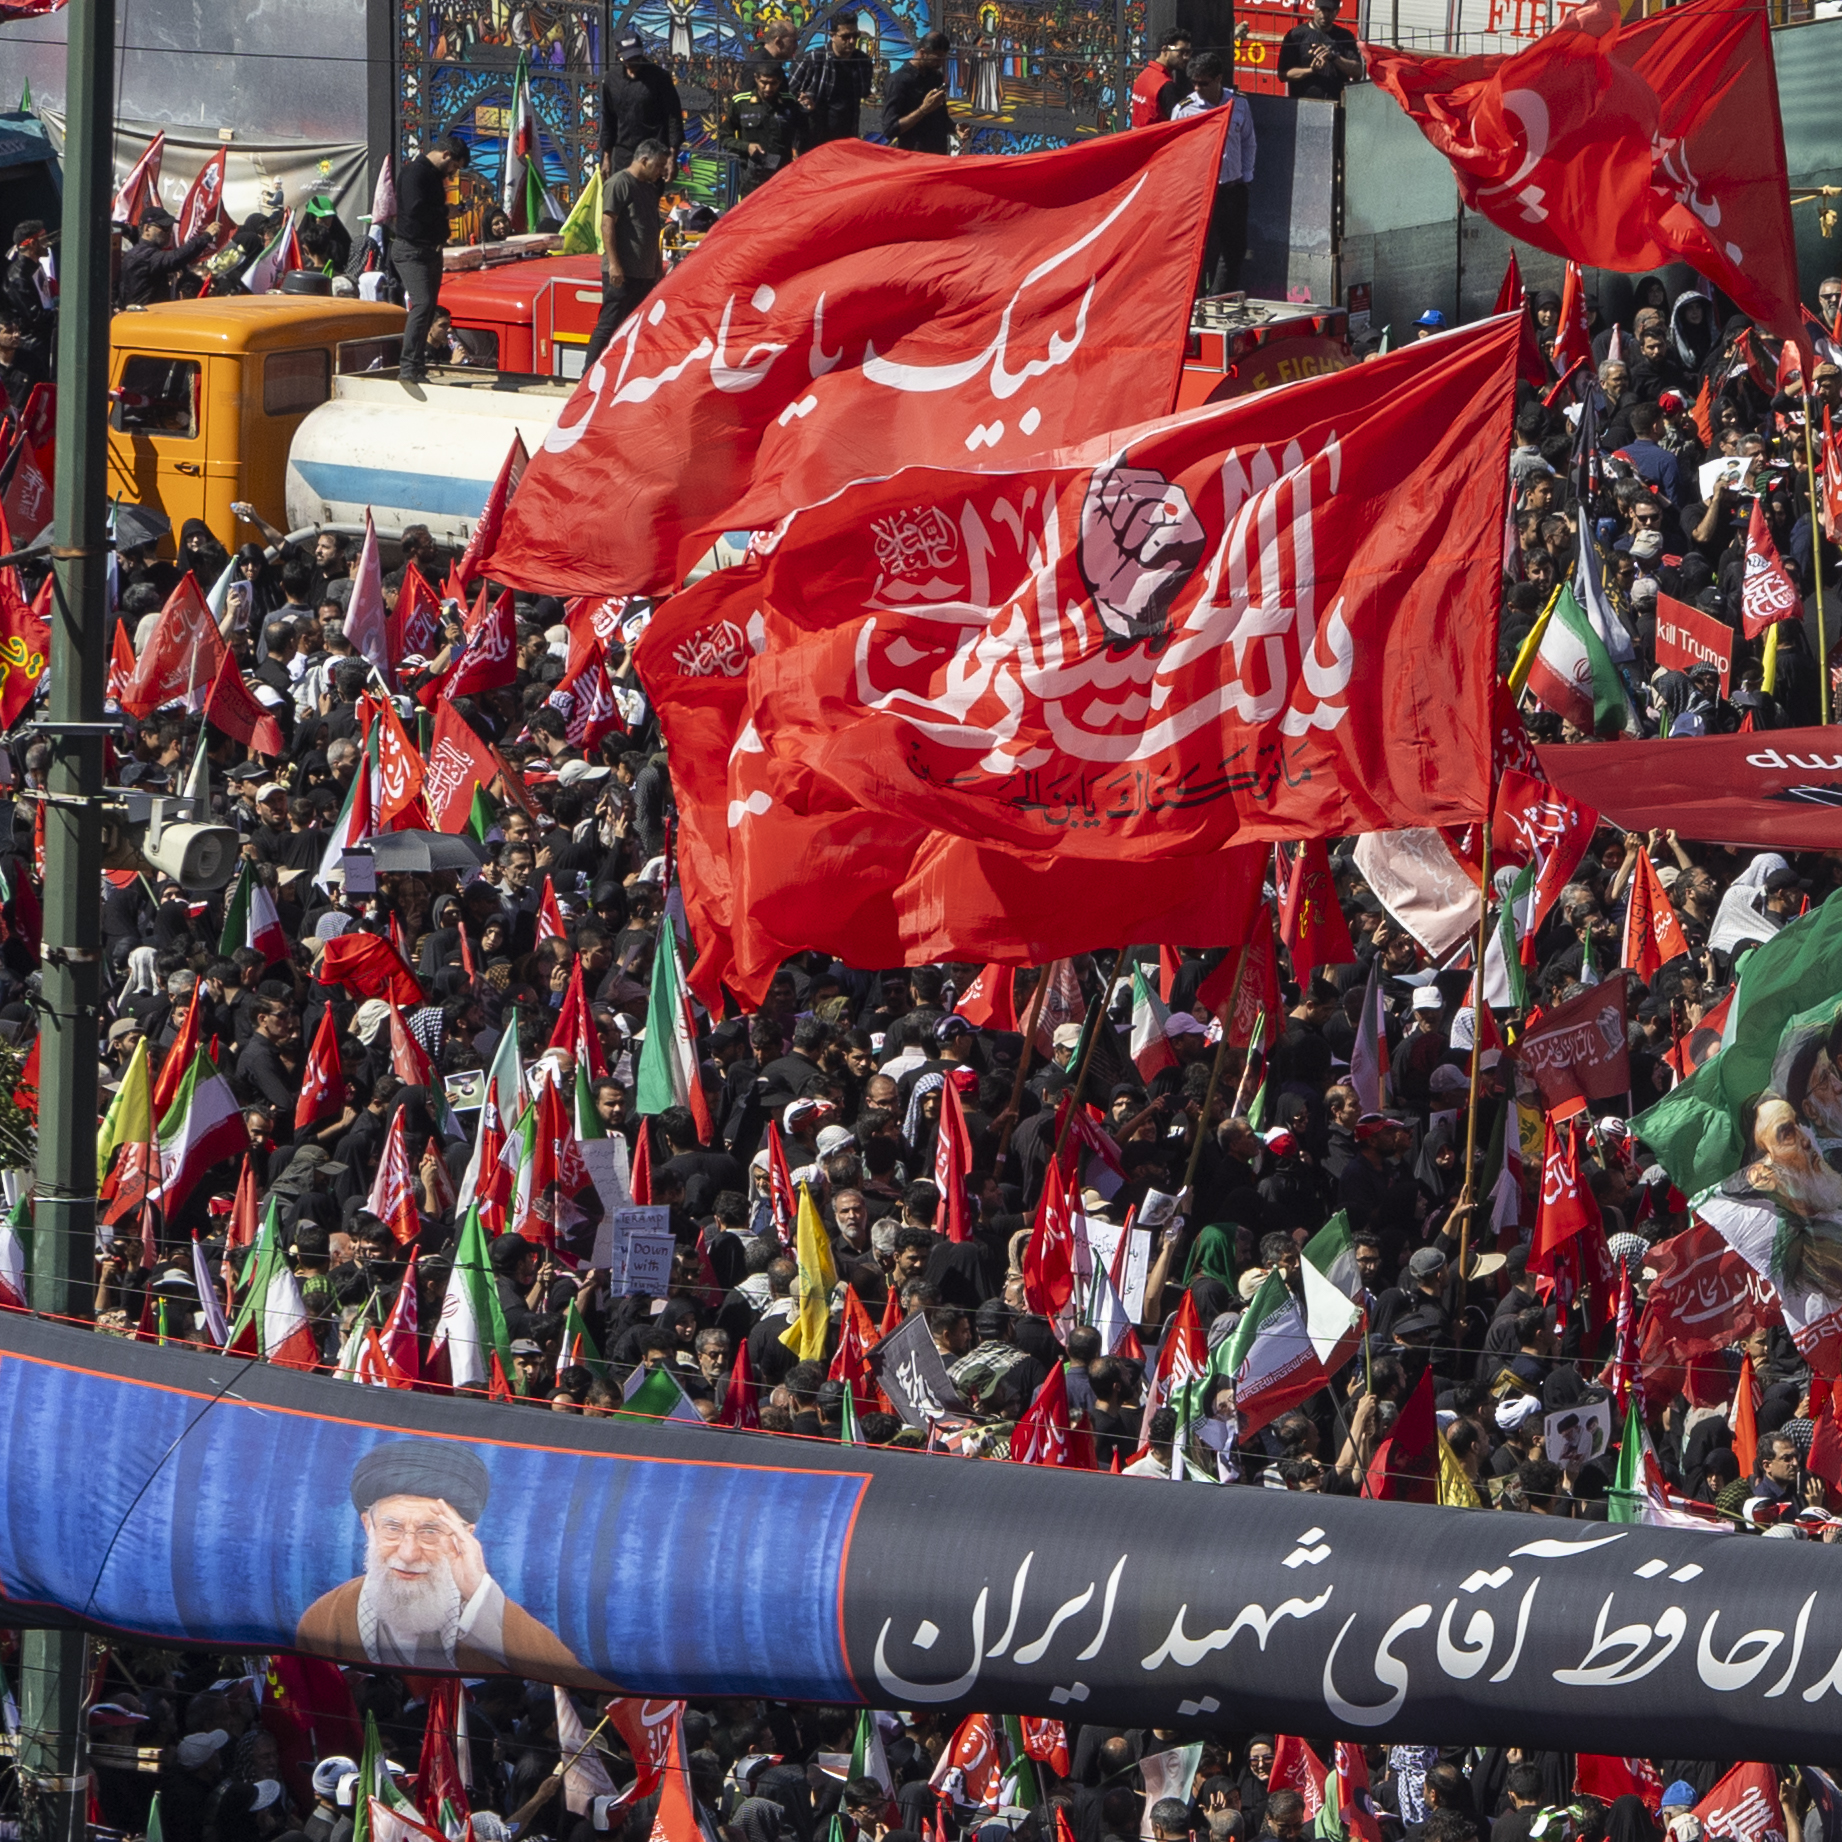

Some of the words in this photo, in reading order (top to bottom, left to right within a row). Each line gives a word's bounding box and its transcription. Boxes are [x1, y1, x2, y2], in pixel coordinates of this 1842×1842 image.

[778, 291, 844, 427] یا
[862, 171, 1149, 452] لبیک
[1657, 618, 1677, 645] kill
[1679, 628, 1729, 676] Trump
[874, 1550, 1128, 1703] ایران
[1141, 1527, 1334, 1713] شهید
[1323, 1532, 1630, 1727] آقای
